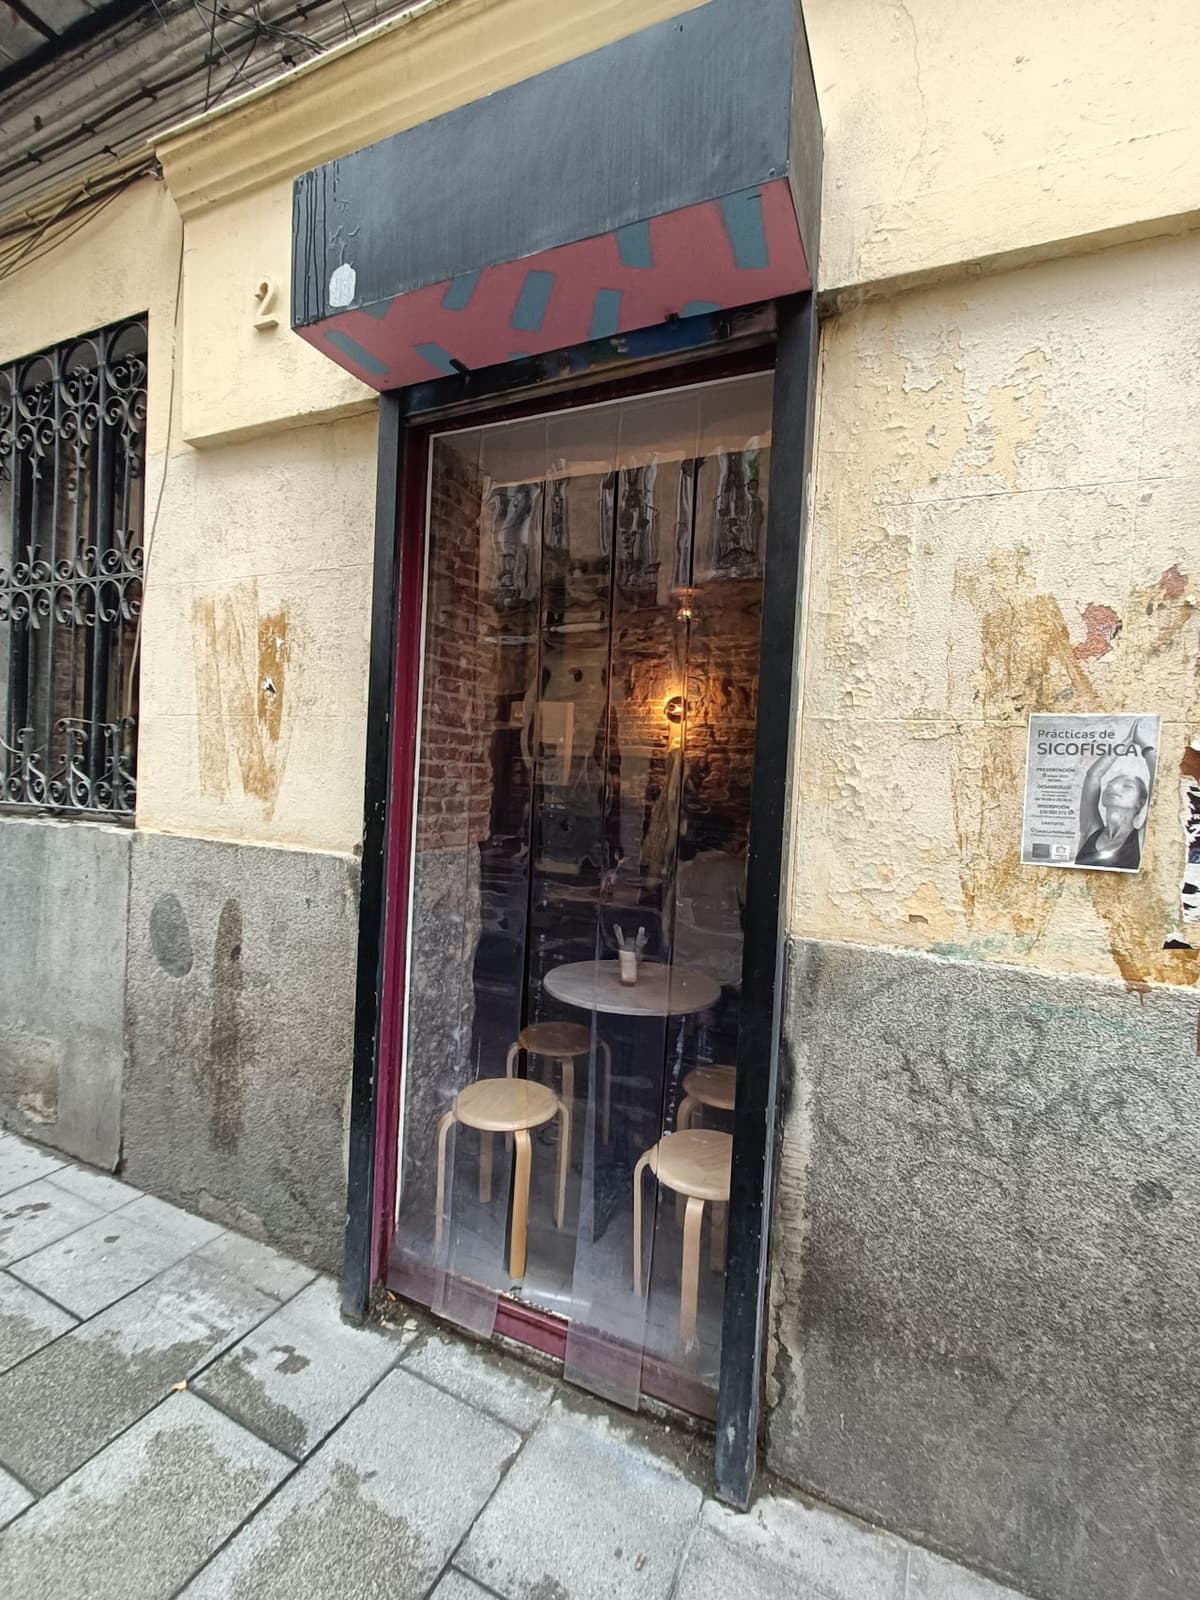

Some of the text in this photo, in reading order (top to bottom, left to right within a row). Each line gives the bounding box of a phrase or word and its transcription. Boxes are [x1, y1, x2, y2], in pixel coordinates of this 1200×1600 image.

[1037, 729, 1116, 740] Prácticas de
[1036, 740, 1138, 757] SICOFÍSICA
